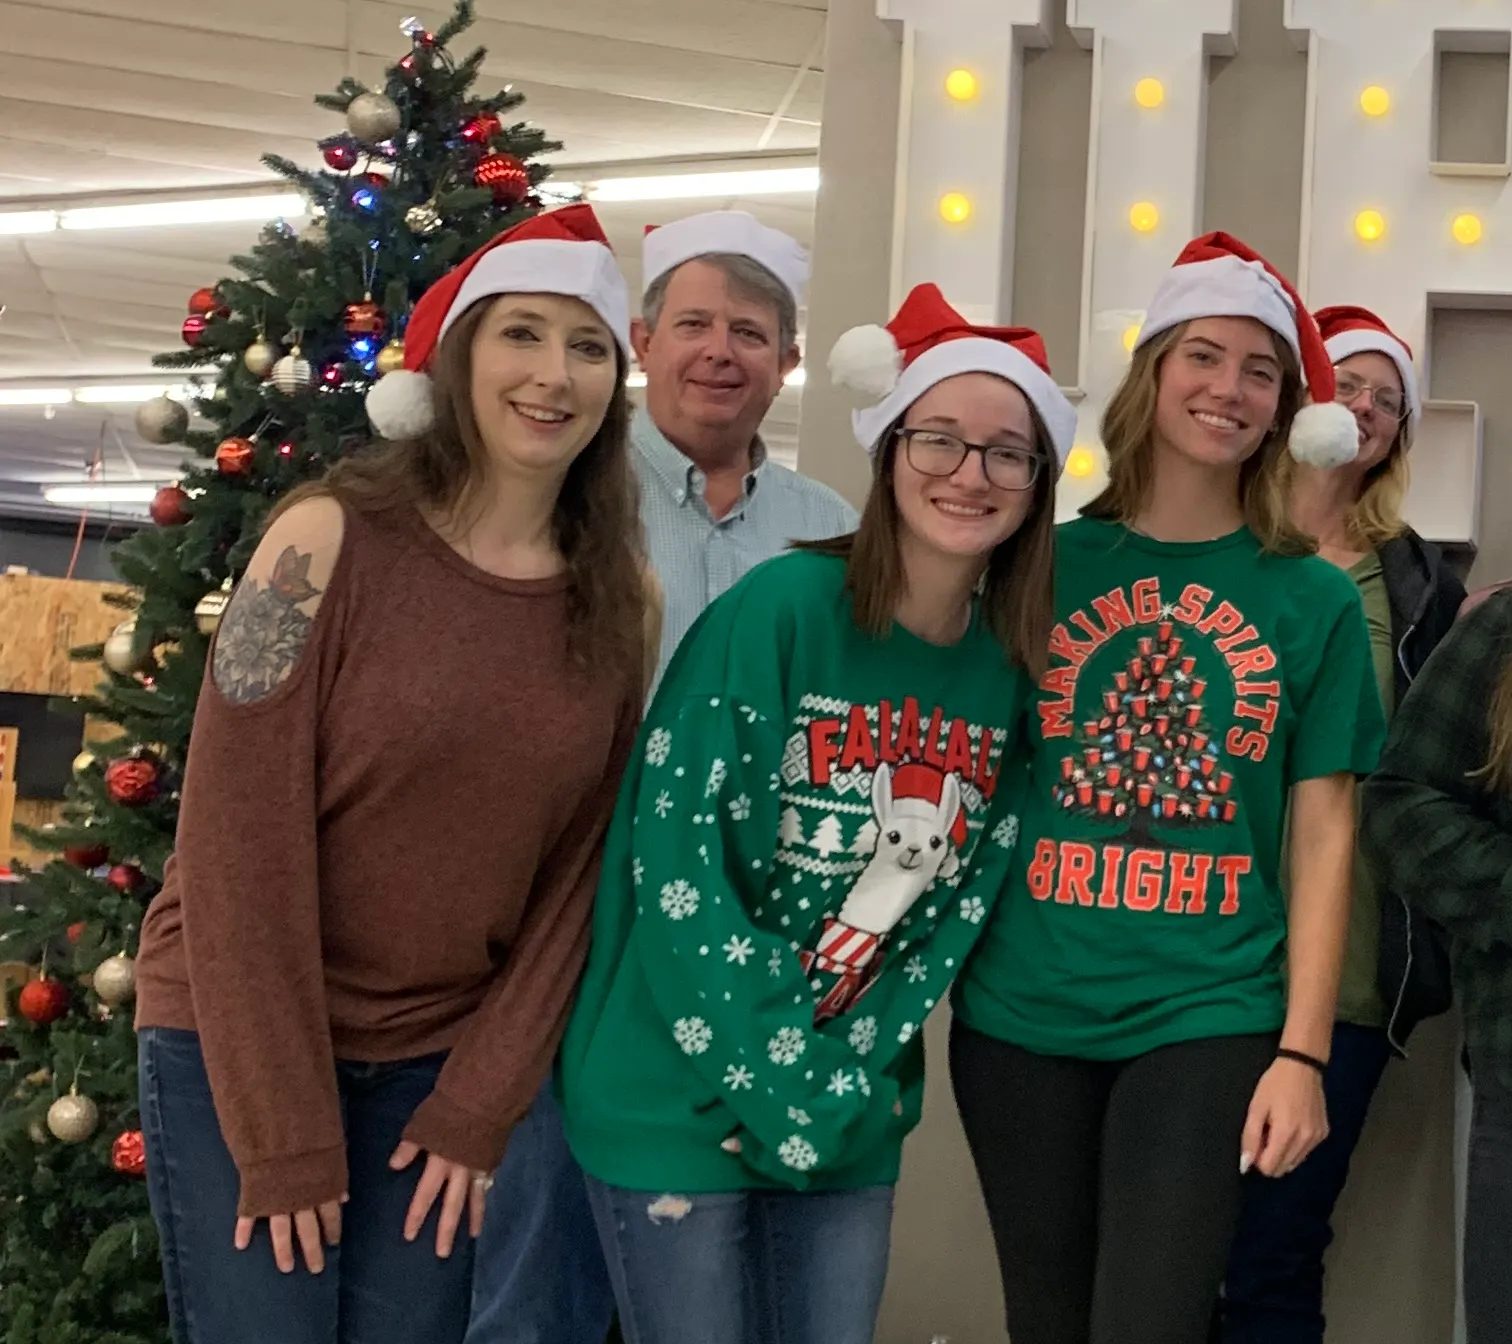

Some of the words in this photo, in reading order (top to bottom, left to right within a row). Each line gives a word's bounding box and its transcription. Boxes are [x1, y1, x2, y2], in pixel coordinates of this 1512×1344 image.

[1037, 576, 1161, 739] MAKING
[1173, 582, 1281, 763] SPIRITS
[1027, 838, 1252, 916] BRIGHT
